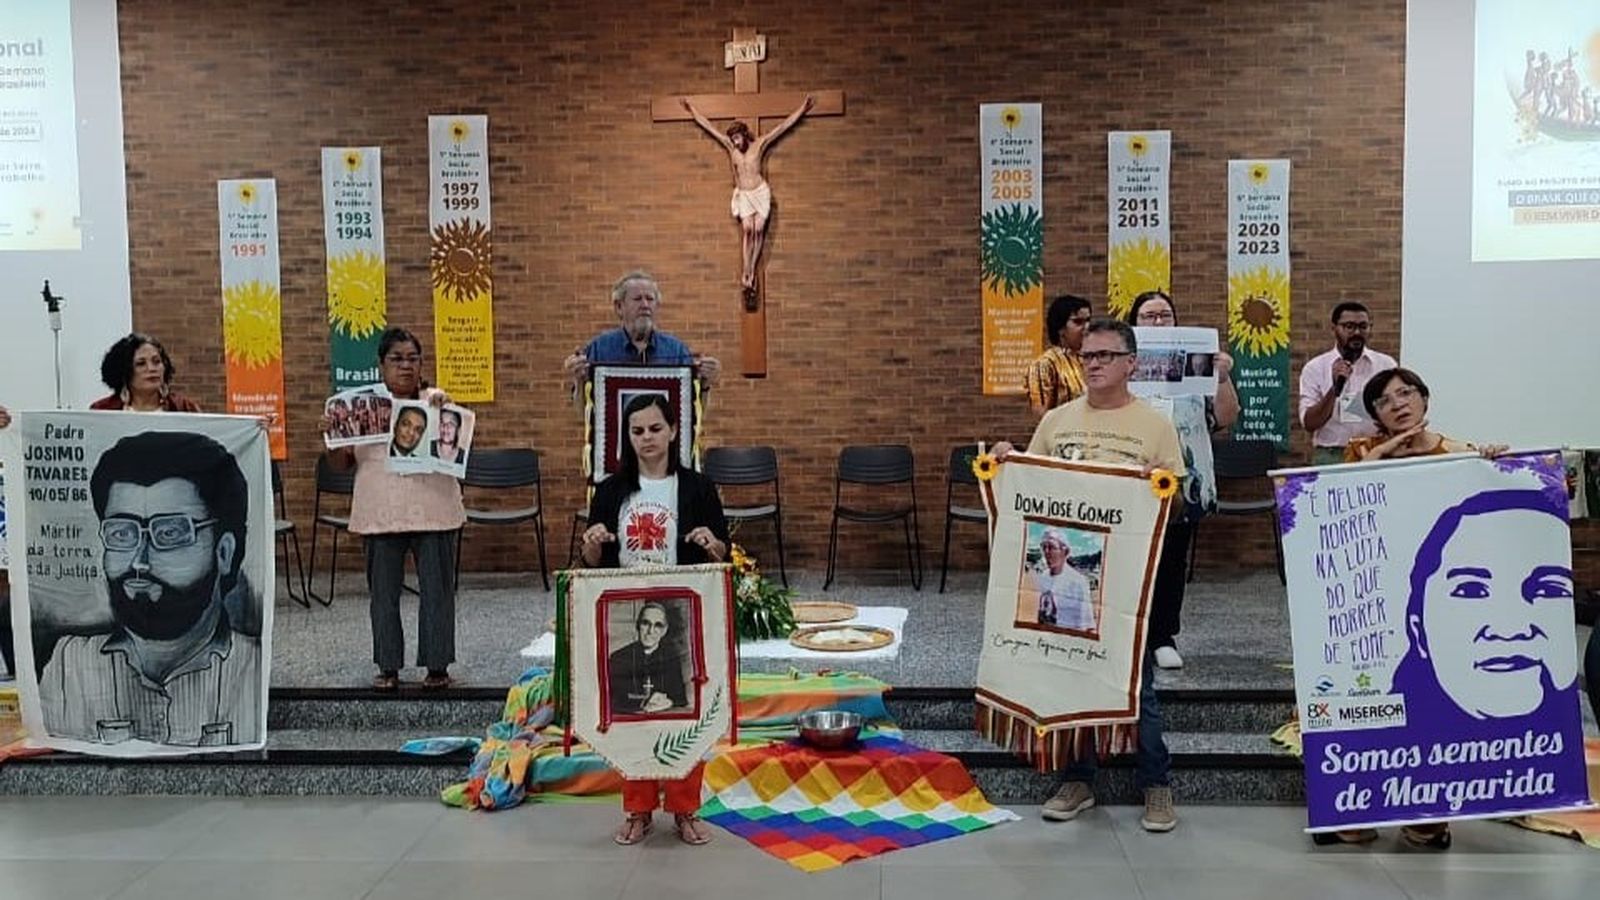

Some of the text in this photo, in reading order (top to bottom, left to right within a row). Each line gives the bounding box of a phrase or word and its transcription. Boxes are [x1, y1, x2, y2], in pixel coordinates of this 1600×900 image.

[991, 169, 1032, 184] 2003
[442, 182, 479, 195] 1997
[991, 185, 1032, 199] 2005
[443, 197, 480, 211] 1999
[1118, 198, 1157, 211] 2011
[335, 212, 371, 224] 1993
[1118, 213, 1160, 227] 2015
[336, 227, 372, 239] 1994
[1238, 223, 1280, 237] 2020
[231, 244, 266, 257] 1991
[1238, 241, 1280, 255] 2023
[336, 367, 379, 381] Brasil
[1250, 396, 1270, 407] por
[45, 423, 84, 440] Padre
[25, 445, 84, 462] JOSIMO
[26, 465, 88, 482] TAVARES
[1328, 481, 1388, 516] MELHOR
[1319, 509, 1377, 550] MORRER
[52, 544, 92, 558] terra
[1316, 535, 1388, 579] NA LUTA
[37, 561, 50, 576] da
[1326, 565, 1384, 609] DO QUE
[1328, 596, 1387, 638] MORRER
[1324, 641, 1342, 665] DE
[1339, 703, 1404, 720] MISEREOR
[1321, 729, 1563, 774] Somos sementes
[1335, 767, 1556, 811] de Margarida
